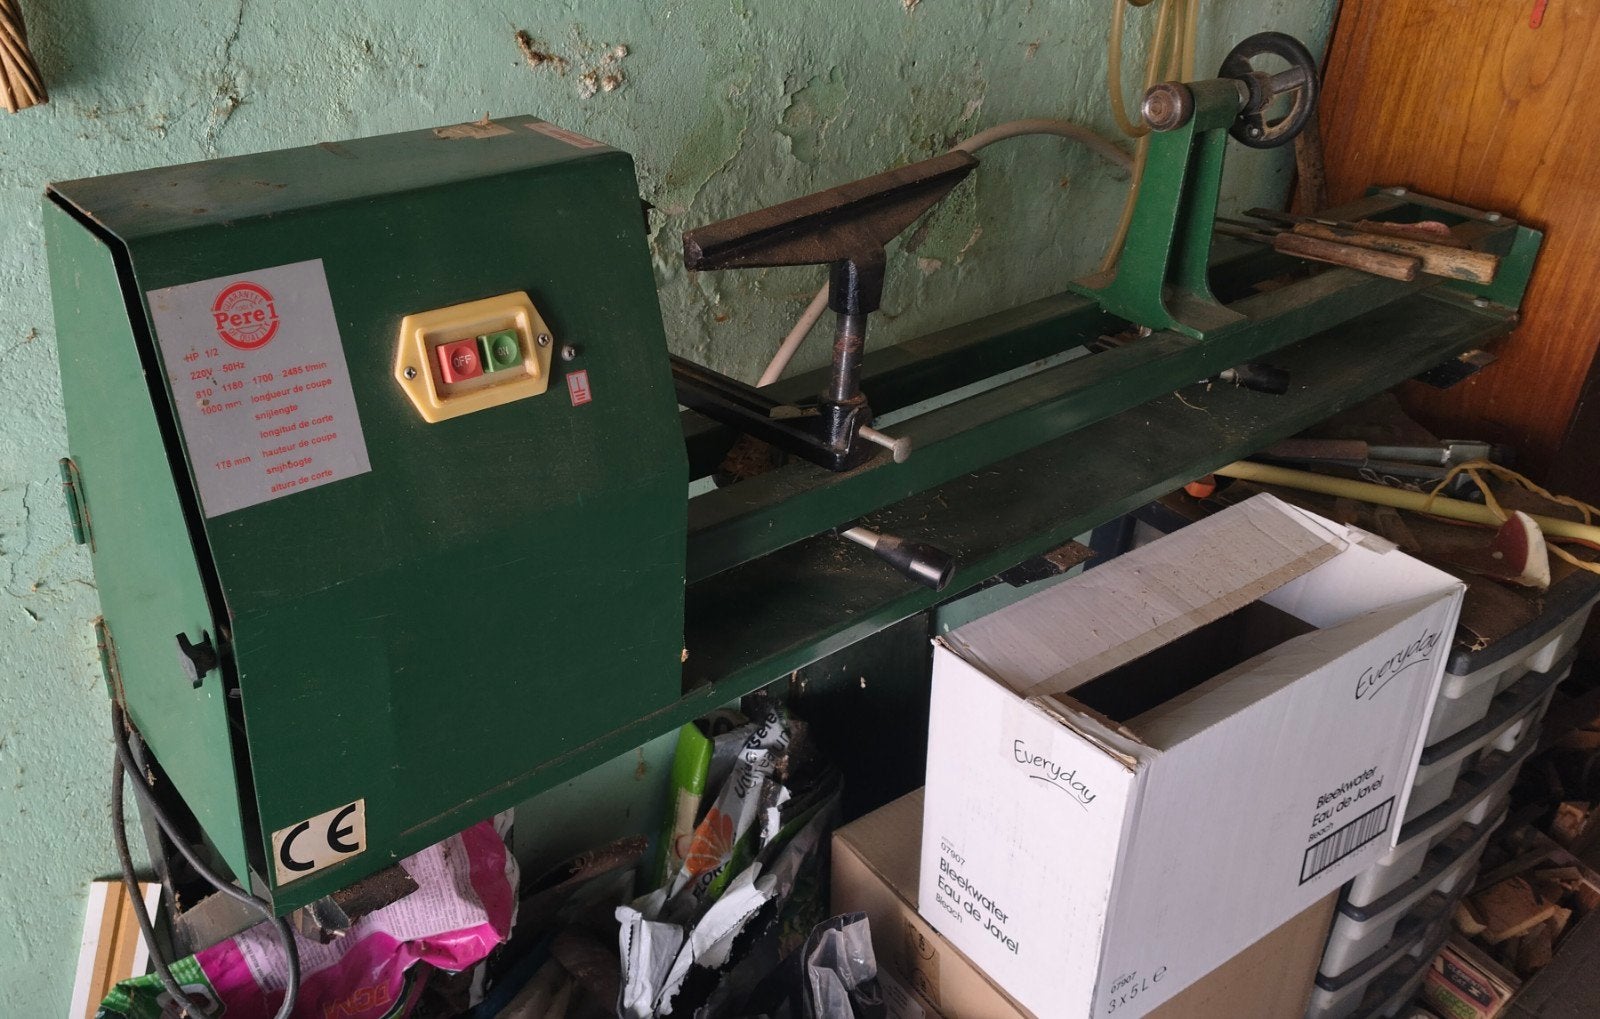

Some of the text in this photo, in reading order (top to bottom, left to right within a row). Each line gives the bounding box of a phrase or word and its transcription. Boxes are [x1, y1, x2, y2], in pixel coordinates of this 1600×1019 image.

[213, 303, 279, 331] Perel
[185, 348, 219, 363] HP 1/2
[453, 354, 472, 368] OFF
[190, 368, 213, 380] 220V
[195, 389, 213, 399] 810
[252, 374, 274, 384] 1700
[282, 367, 303, 377] 2485
[305, 362, 327, 372] t/min
[201, 378, 332, 415] 1000 mm longueur de coupe
[260, 415, 334, 439] longitud de corte
[234, 456, 251, 466] mm
[262, 444, 296, 458] hauteur
[298, 439, 309, 448] de
[311, 433, 337, 446] coupe
[271, 469, 333, 493] altura de corte
[1355, 628, 1443, 700] Everyday
[1014, 739, 1097, 804] Everyday
[1317, 765, 1377, 810] Bleekwater
[1312, 775, 1384, 828] Eau de Javel
[280, 803, 359, 871] CE
[1309, 822, 1334, 842] Bleach
[940, 842, 966, 866] 07907
[940, 857, 1009, 925] Bleekwater
[935, 893, 963, 923] Bleach
[938, 874, 1019, 955] Eau de Javel
[1107, 999, 1116, 1015] 3
[1119, 994, 1127, 1008] x
[1130, 983, 1139, 999] 5
[1142, 978, 1149, 992] L
[1110, 970, 1138, 994] 07907
